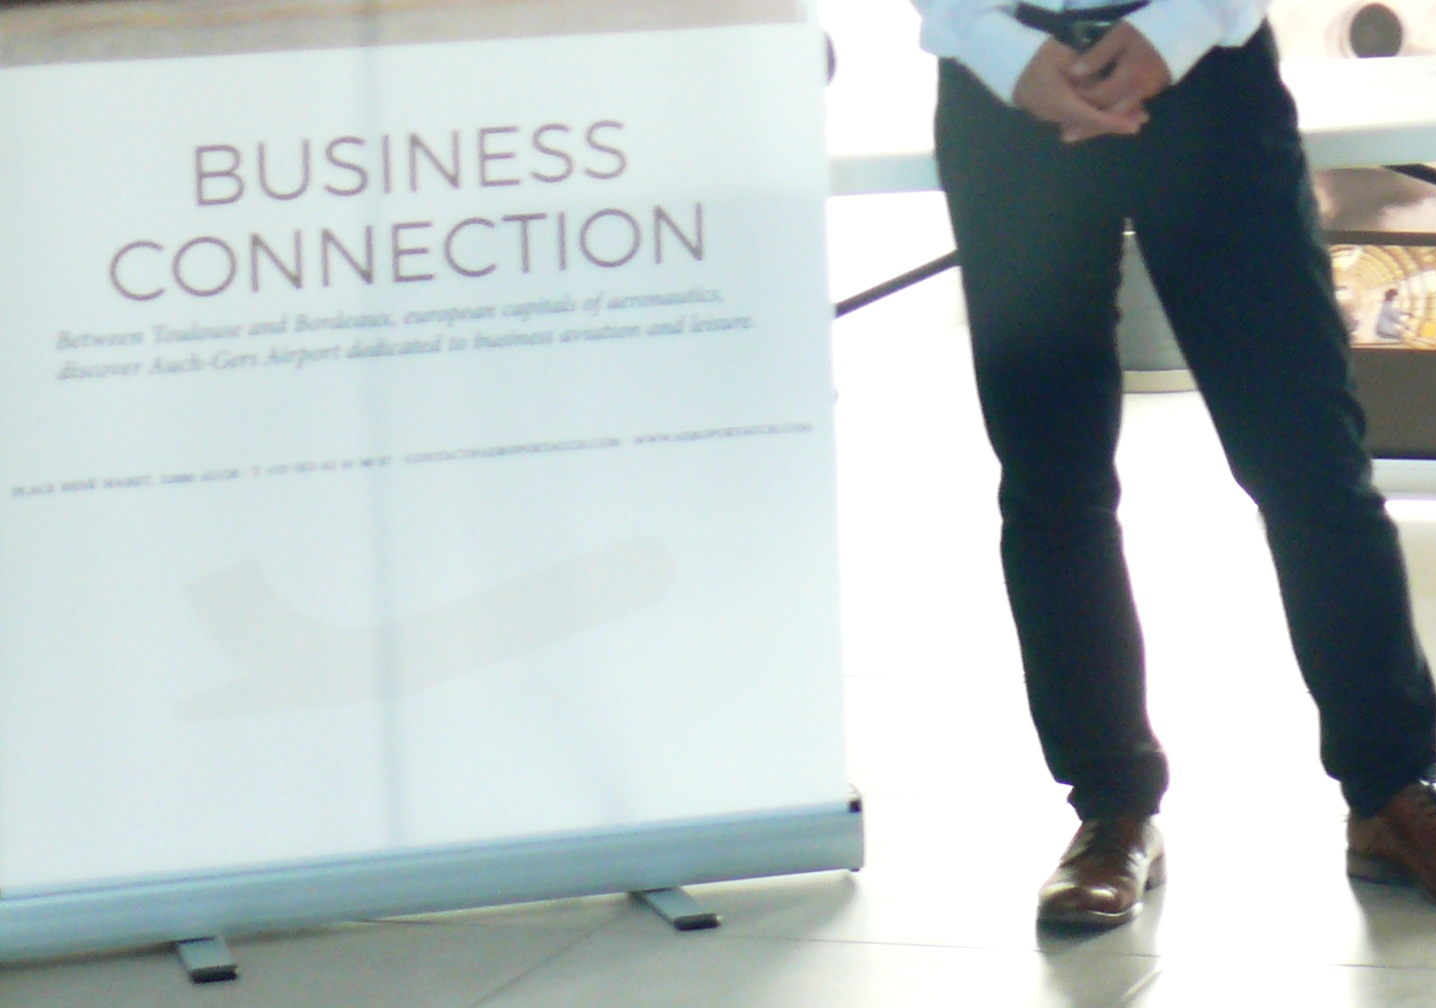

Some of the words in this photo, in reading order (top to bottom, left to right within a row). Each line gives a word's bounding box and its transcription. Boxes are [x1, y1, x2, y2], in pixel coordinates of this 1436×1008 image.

[193, 119, 629, 207] BUSINESS
[109, 202, 706, 301] CONNECTION
[56, 330, 144, 350] Between
[153, 325, 243, 343] Toulouse
[247, 316, 288, 336] and
[403, 306, 496, 326] european
[502, 295, 577, 318] capitals
[581, 293, 606, 316] of
[56, 361, 143, 381] discover
[148, 354, 259, 374] Auch-Gers
[263, 347, 341, 369] Airport
[347, 339, 444, 359] dedicated
[448, 338, 469, 351] to
[474, 332, 555, 349] business
[559, 326, 641, 343] aviation
[646, 321, 686, 337] and
